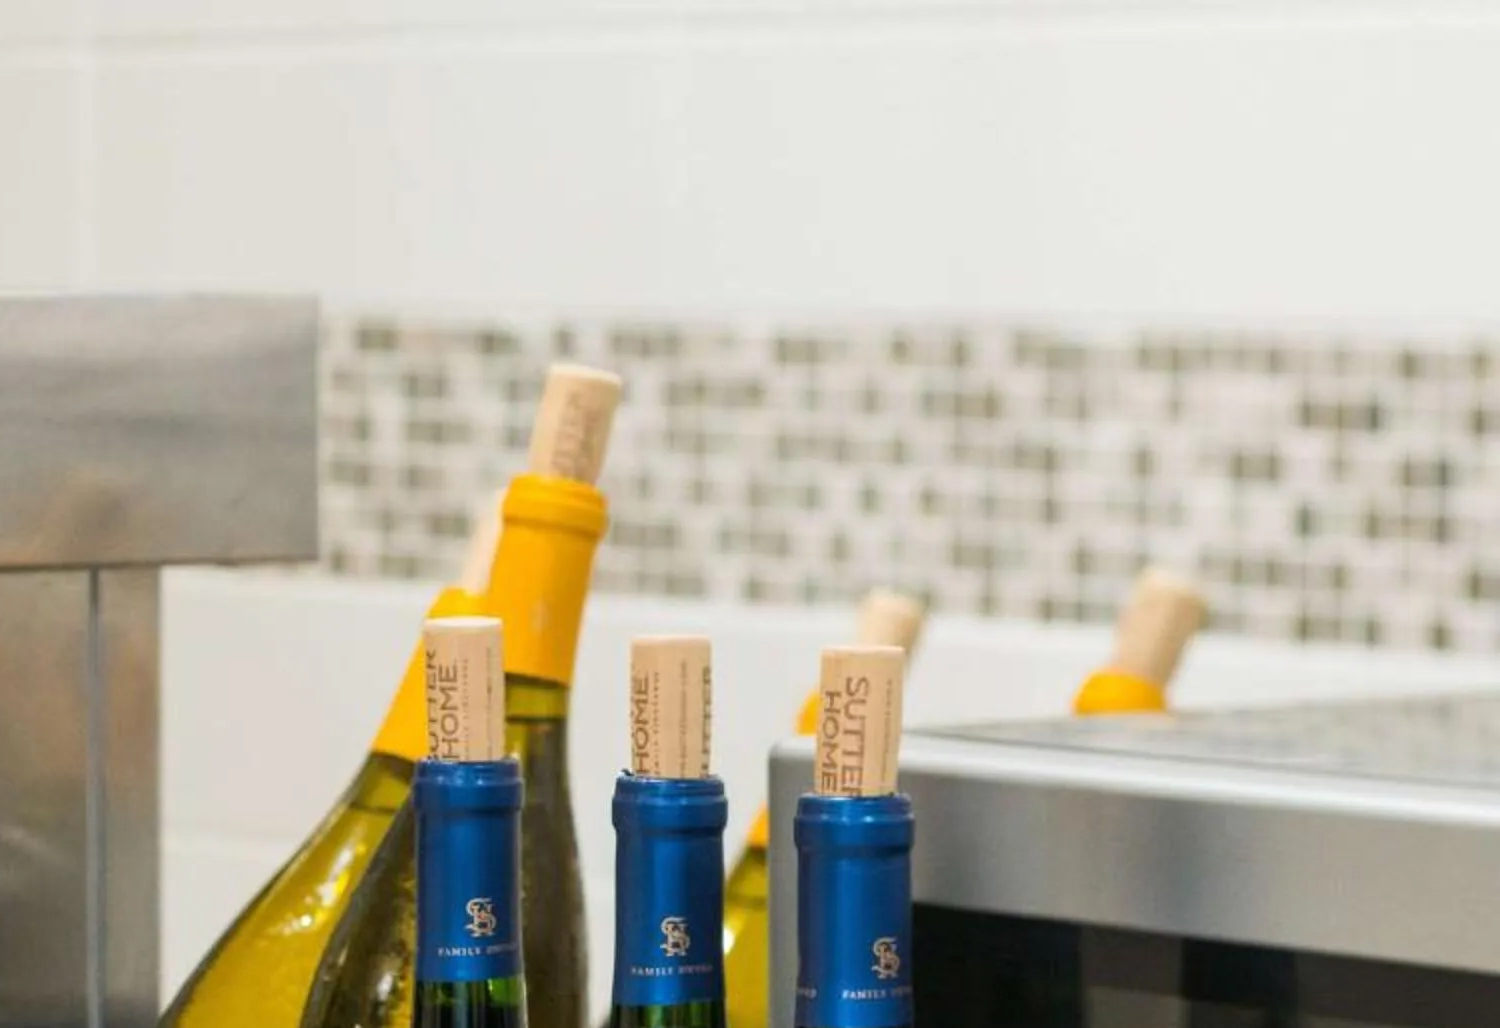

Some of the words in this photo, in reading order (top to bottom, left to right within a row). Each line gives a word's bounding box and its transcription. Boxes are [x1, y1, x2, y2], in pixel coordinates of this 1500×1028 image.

[438, 662, 459, 761] HOME
[634, 672, 650, 774] HOME
[822, 690, 842, 794] HOME
